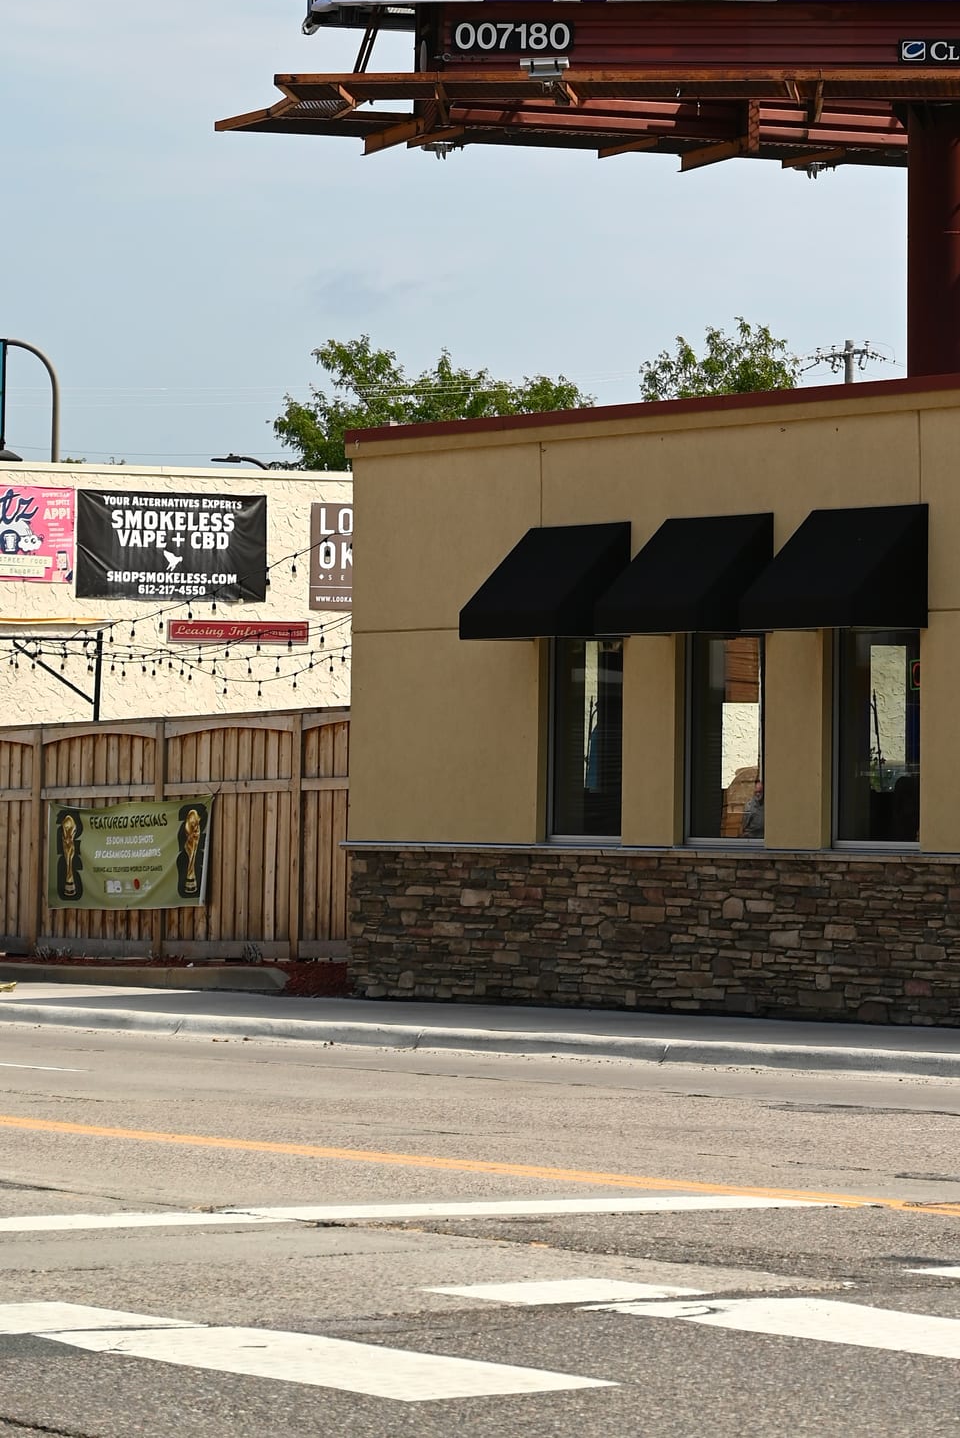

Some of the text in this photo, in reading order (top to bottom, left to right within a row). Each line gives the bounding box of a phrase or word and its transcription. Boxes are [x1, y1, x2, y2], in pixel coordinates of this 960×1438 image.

[455, 22, 571, 51] 007180
[43, 507, 71, 520] APP!
[111, 510, 235, 532] SMOKELESS
[117, 530, 230, 550] VAPE + CBD
[106, 570, 238, 585] SHOPSMOKELESS.COM
[138, 584, 207, 596] 612-217-4550
[175, 625, 225, 638] Leasing
[89, 813, 168, 830] FEATURED SPECIALS
